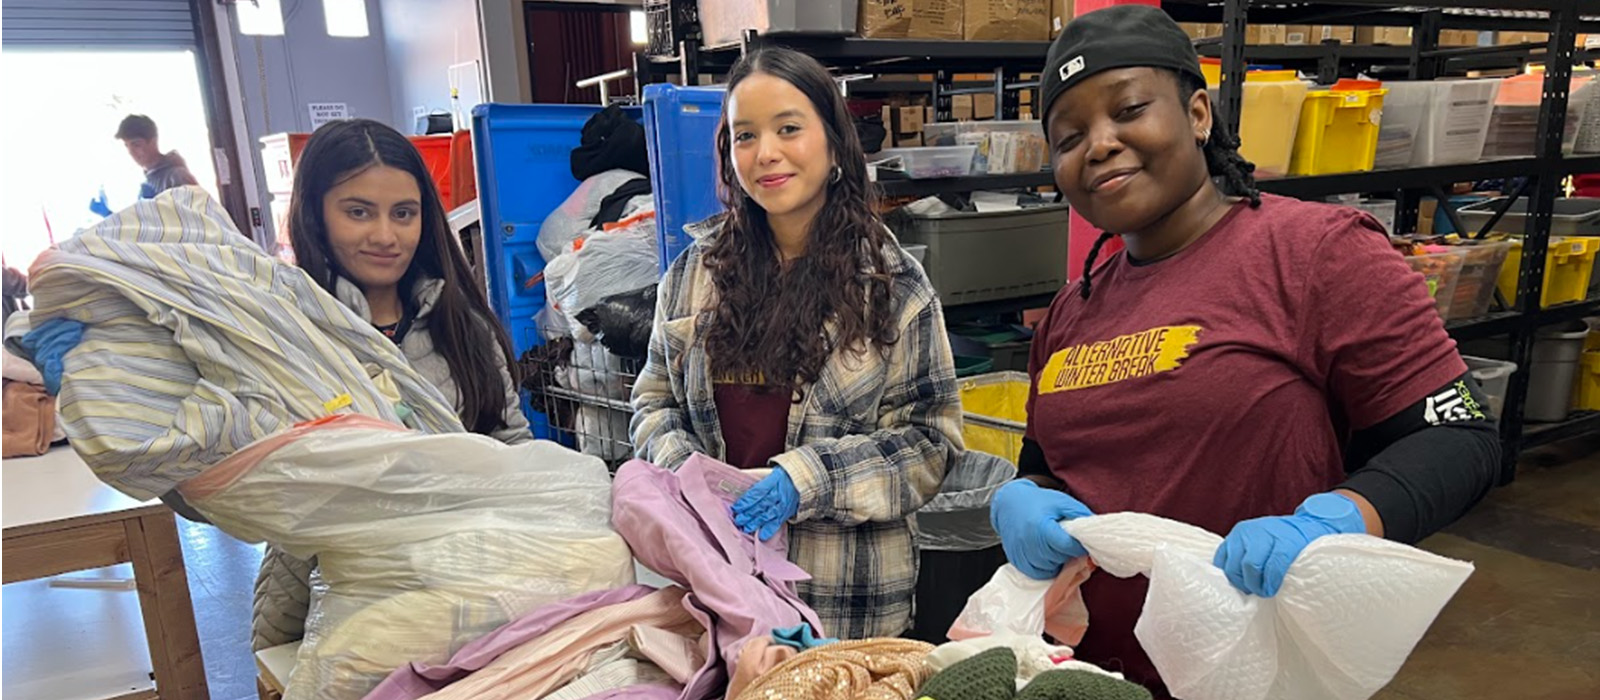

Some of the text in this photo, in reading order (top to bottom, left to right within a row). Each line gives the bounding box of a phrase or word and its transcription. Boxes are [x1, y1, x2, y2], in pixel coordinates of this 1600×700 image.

[1063, 329, 1169, 366] ALTERNATIVE
[1054, 353, 1160, 388] WINTER BREAK
